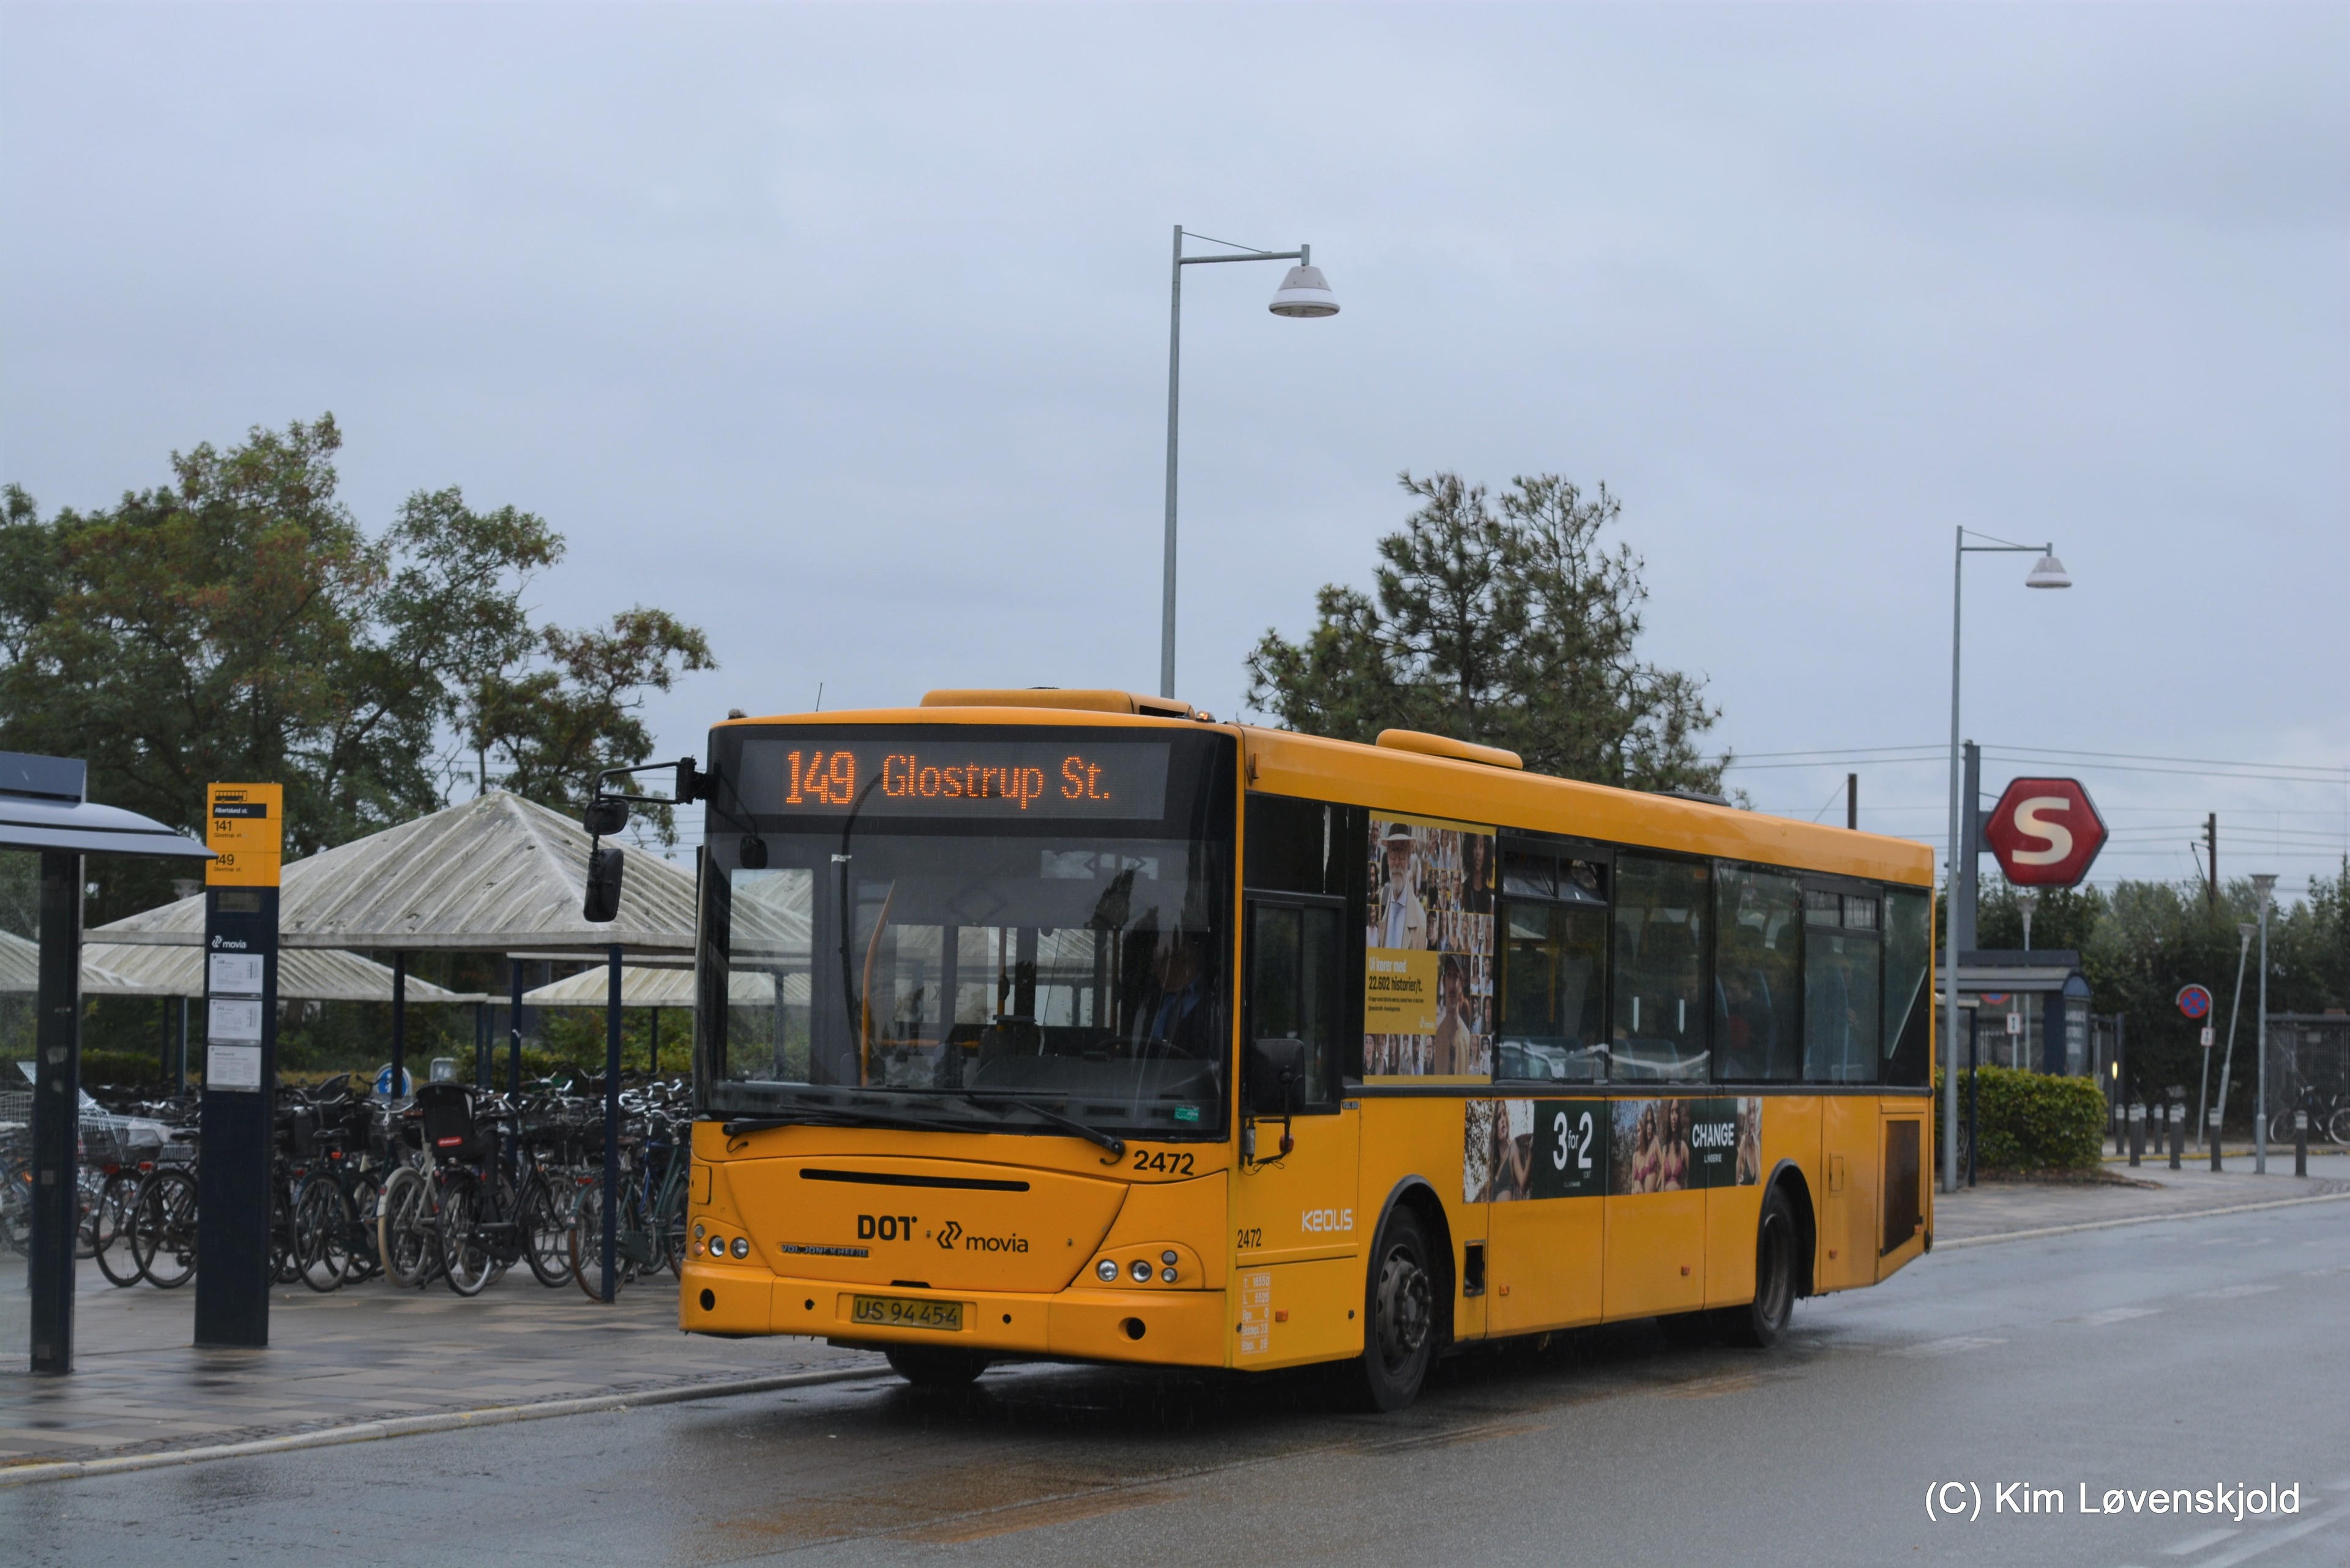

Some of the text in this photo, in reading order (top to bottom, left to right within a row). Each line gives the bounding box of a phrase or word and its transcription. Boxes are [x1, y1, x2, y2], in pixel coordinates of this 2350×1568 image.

[786, 751, 1110, 810] 149 Glostrup St.
[214, 820, 232, 831] 141
[2012, 796, 2073, 865] S
[215, 854, 234, 865] 149
[222, 939, 247, 949] movia
[1393, 959, 1406, 973] med
[1368, 976, 1423, 994] 22.602 historier/t.
[1553, 1111, 1592, 1170] 3 for 2
[1692, 1122, 1734, 1148] CHANGE
[1133, 1150, 1194, 1176] 2472
[857, 1214, 1029, 1253] DOT movia
[1237, 1228, 1262, 1249] 2472
[1255, 1292, 1269, 1303] 5525
[857, 1301, 957, 1325] US 94 454
[1264, 1307, 1269, 1318] 0
[1261, 1323, 1268, 1334] 33
[1260, 1338, 1267, 1350] 39
